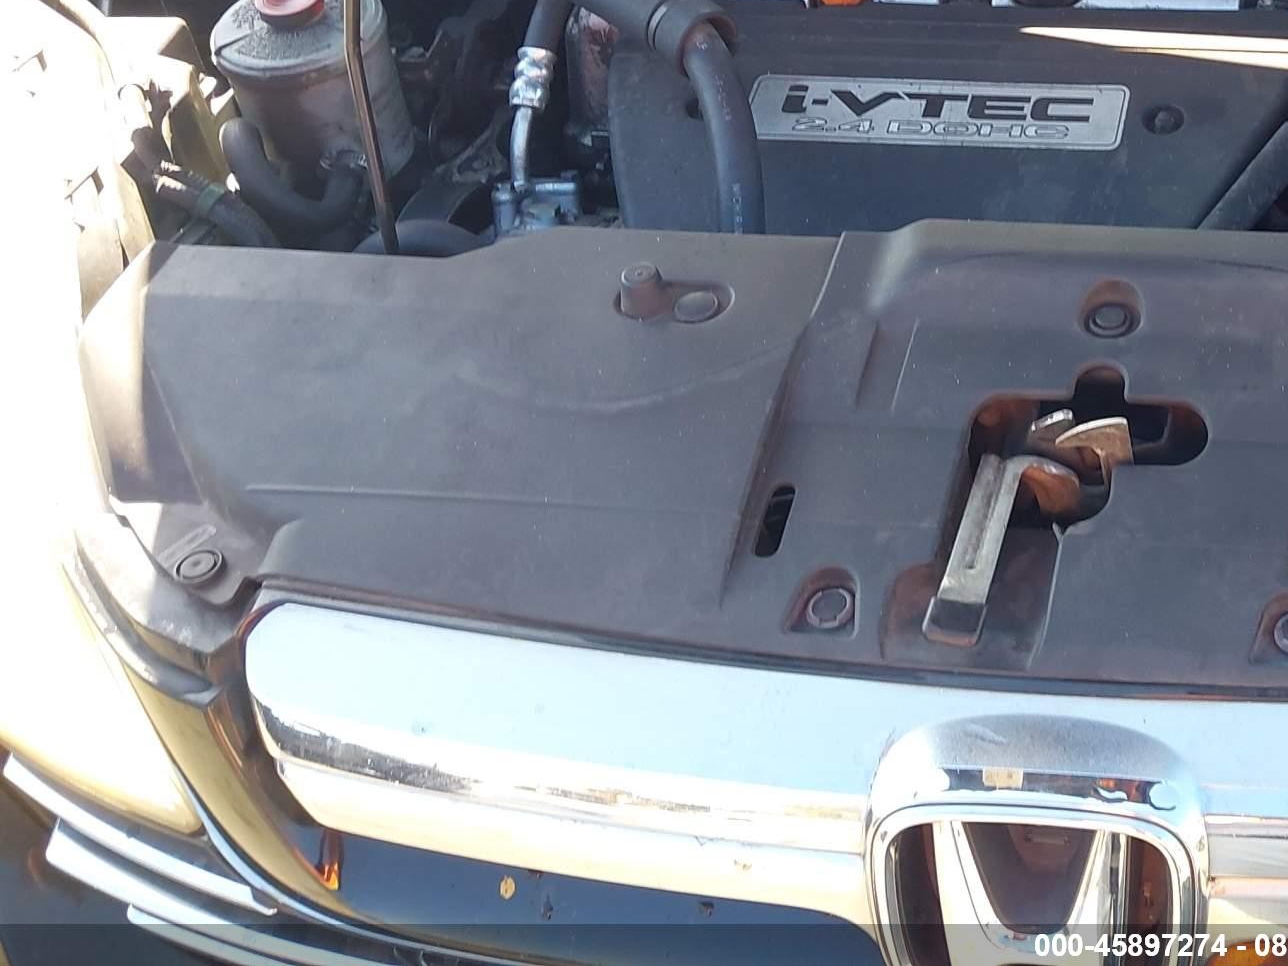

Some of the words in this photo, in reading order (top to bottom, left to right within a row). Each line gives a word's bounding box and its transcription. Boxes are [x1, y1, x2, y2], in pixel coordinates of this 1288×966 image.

[781, 84, 1095, 123] i-VTEC
[791, 117, 874, 134] 2.4
[886, 120, 1071, 139] DOHC
